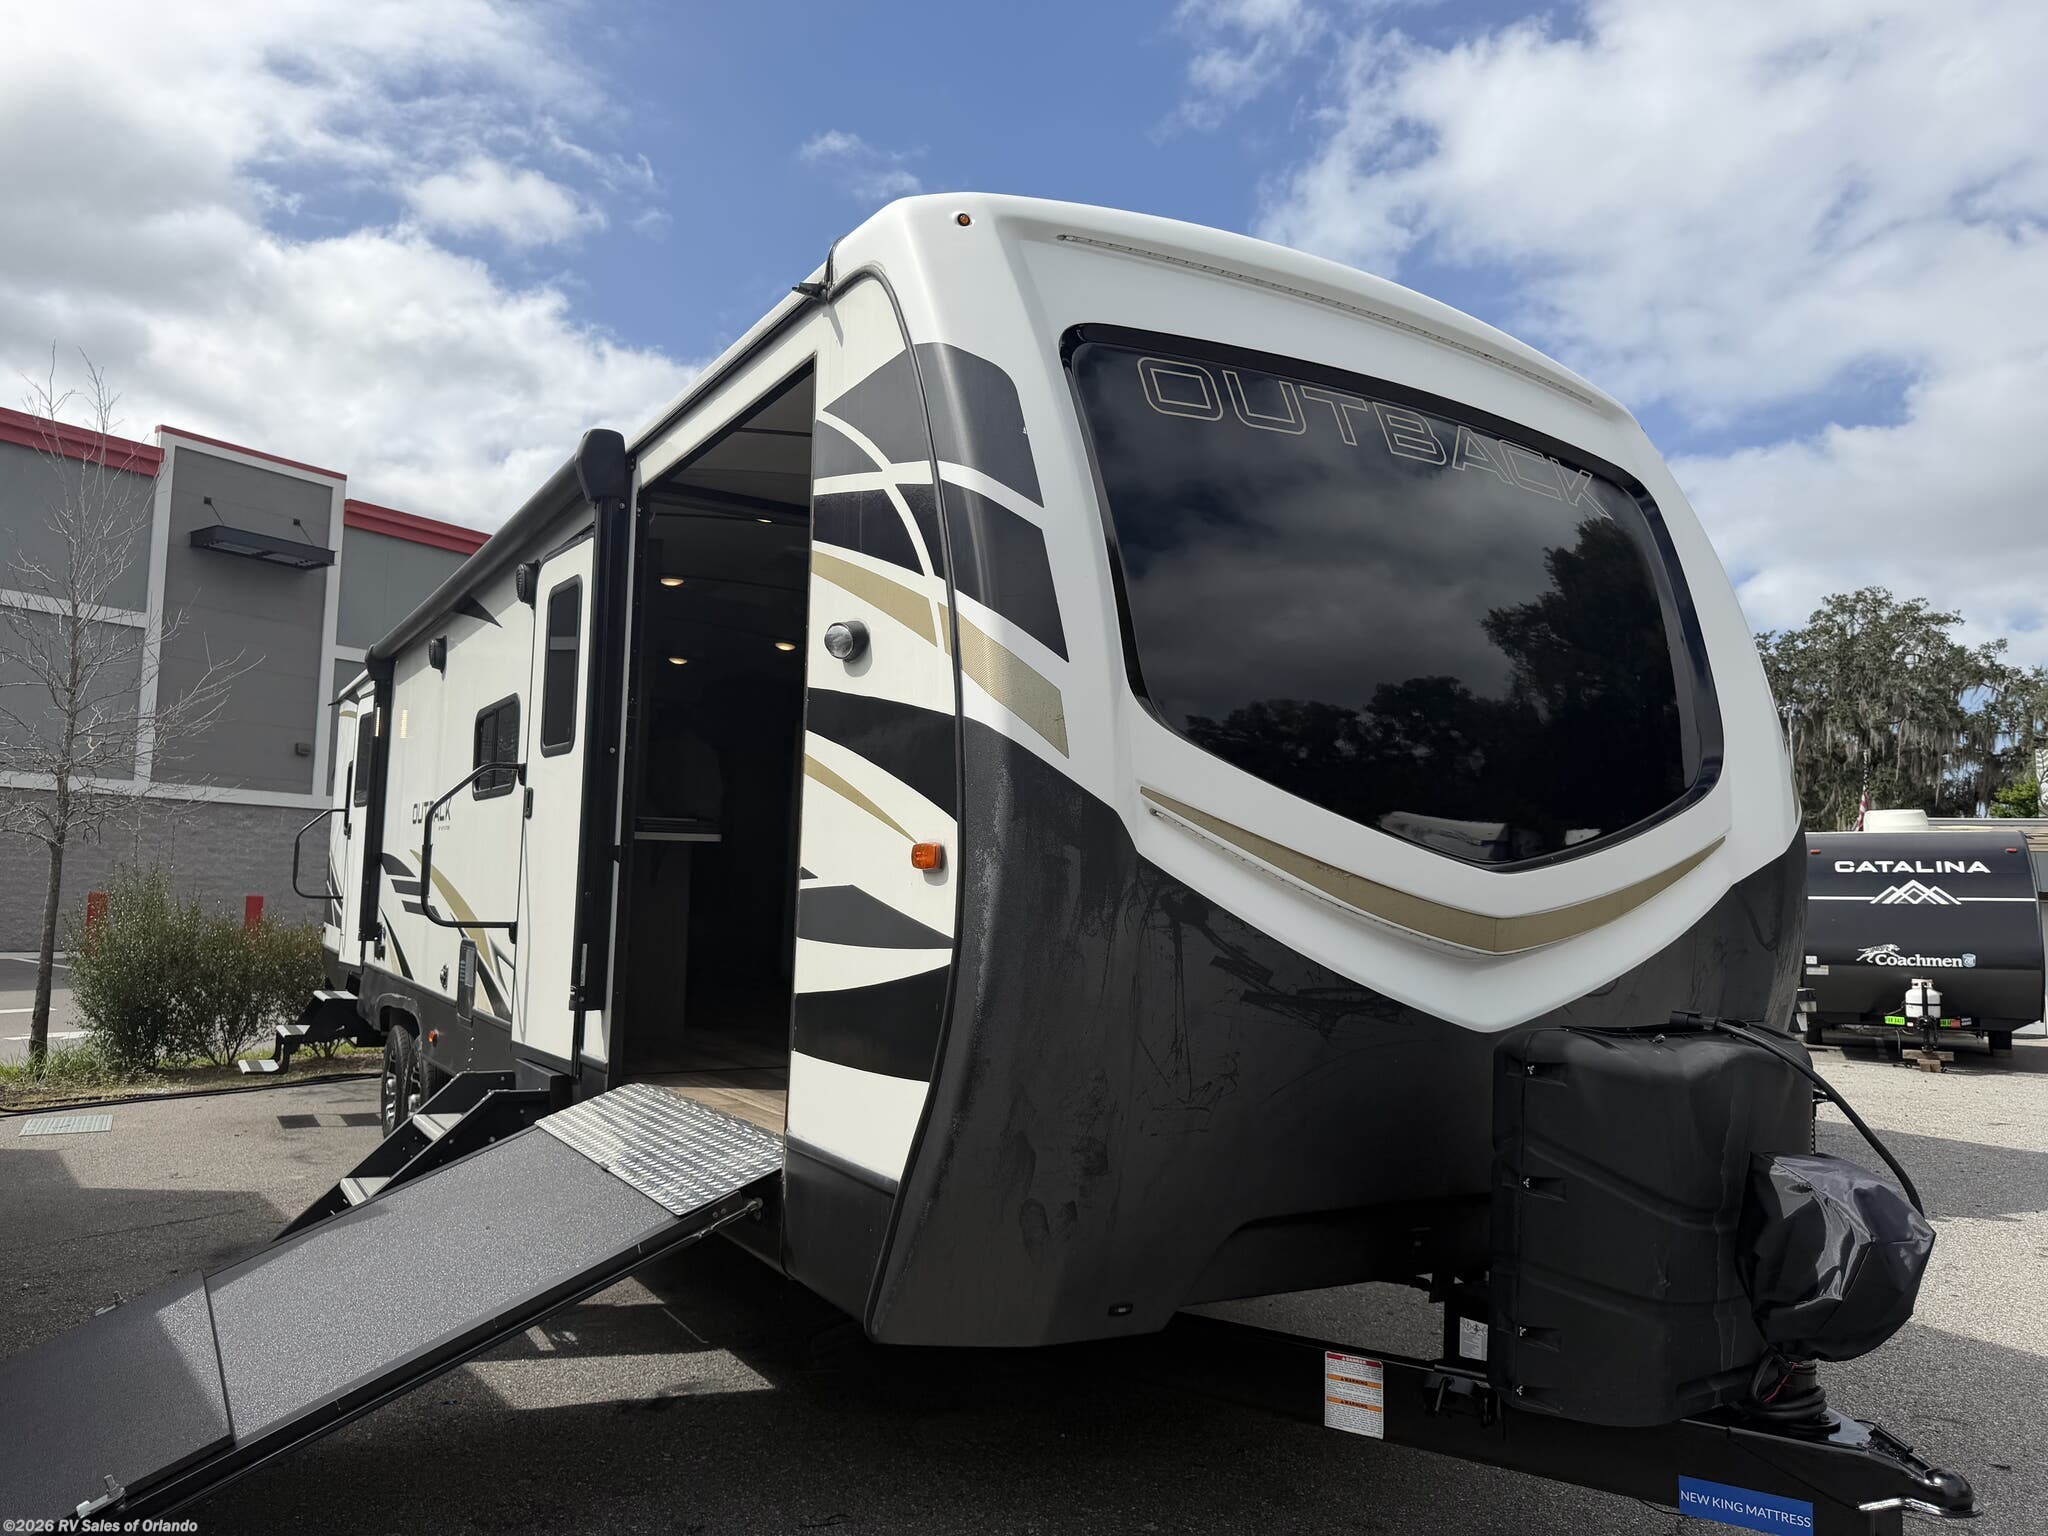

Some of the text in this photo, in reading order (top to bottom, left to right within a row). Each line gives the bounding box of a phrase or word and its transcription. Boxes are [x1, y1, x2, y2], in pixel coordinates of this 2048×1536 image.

[1137, 357, 1613, 519] OUTBACK
[412, 797, 452, 824] OUTACK
[1834, 860, 1991, 874] CATALINA
[1875, 953, 1963, 968] Coachmen
[1680, 1490, 1811, 1528] NEW KING MATTRESS
